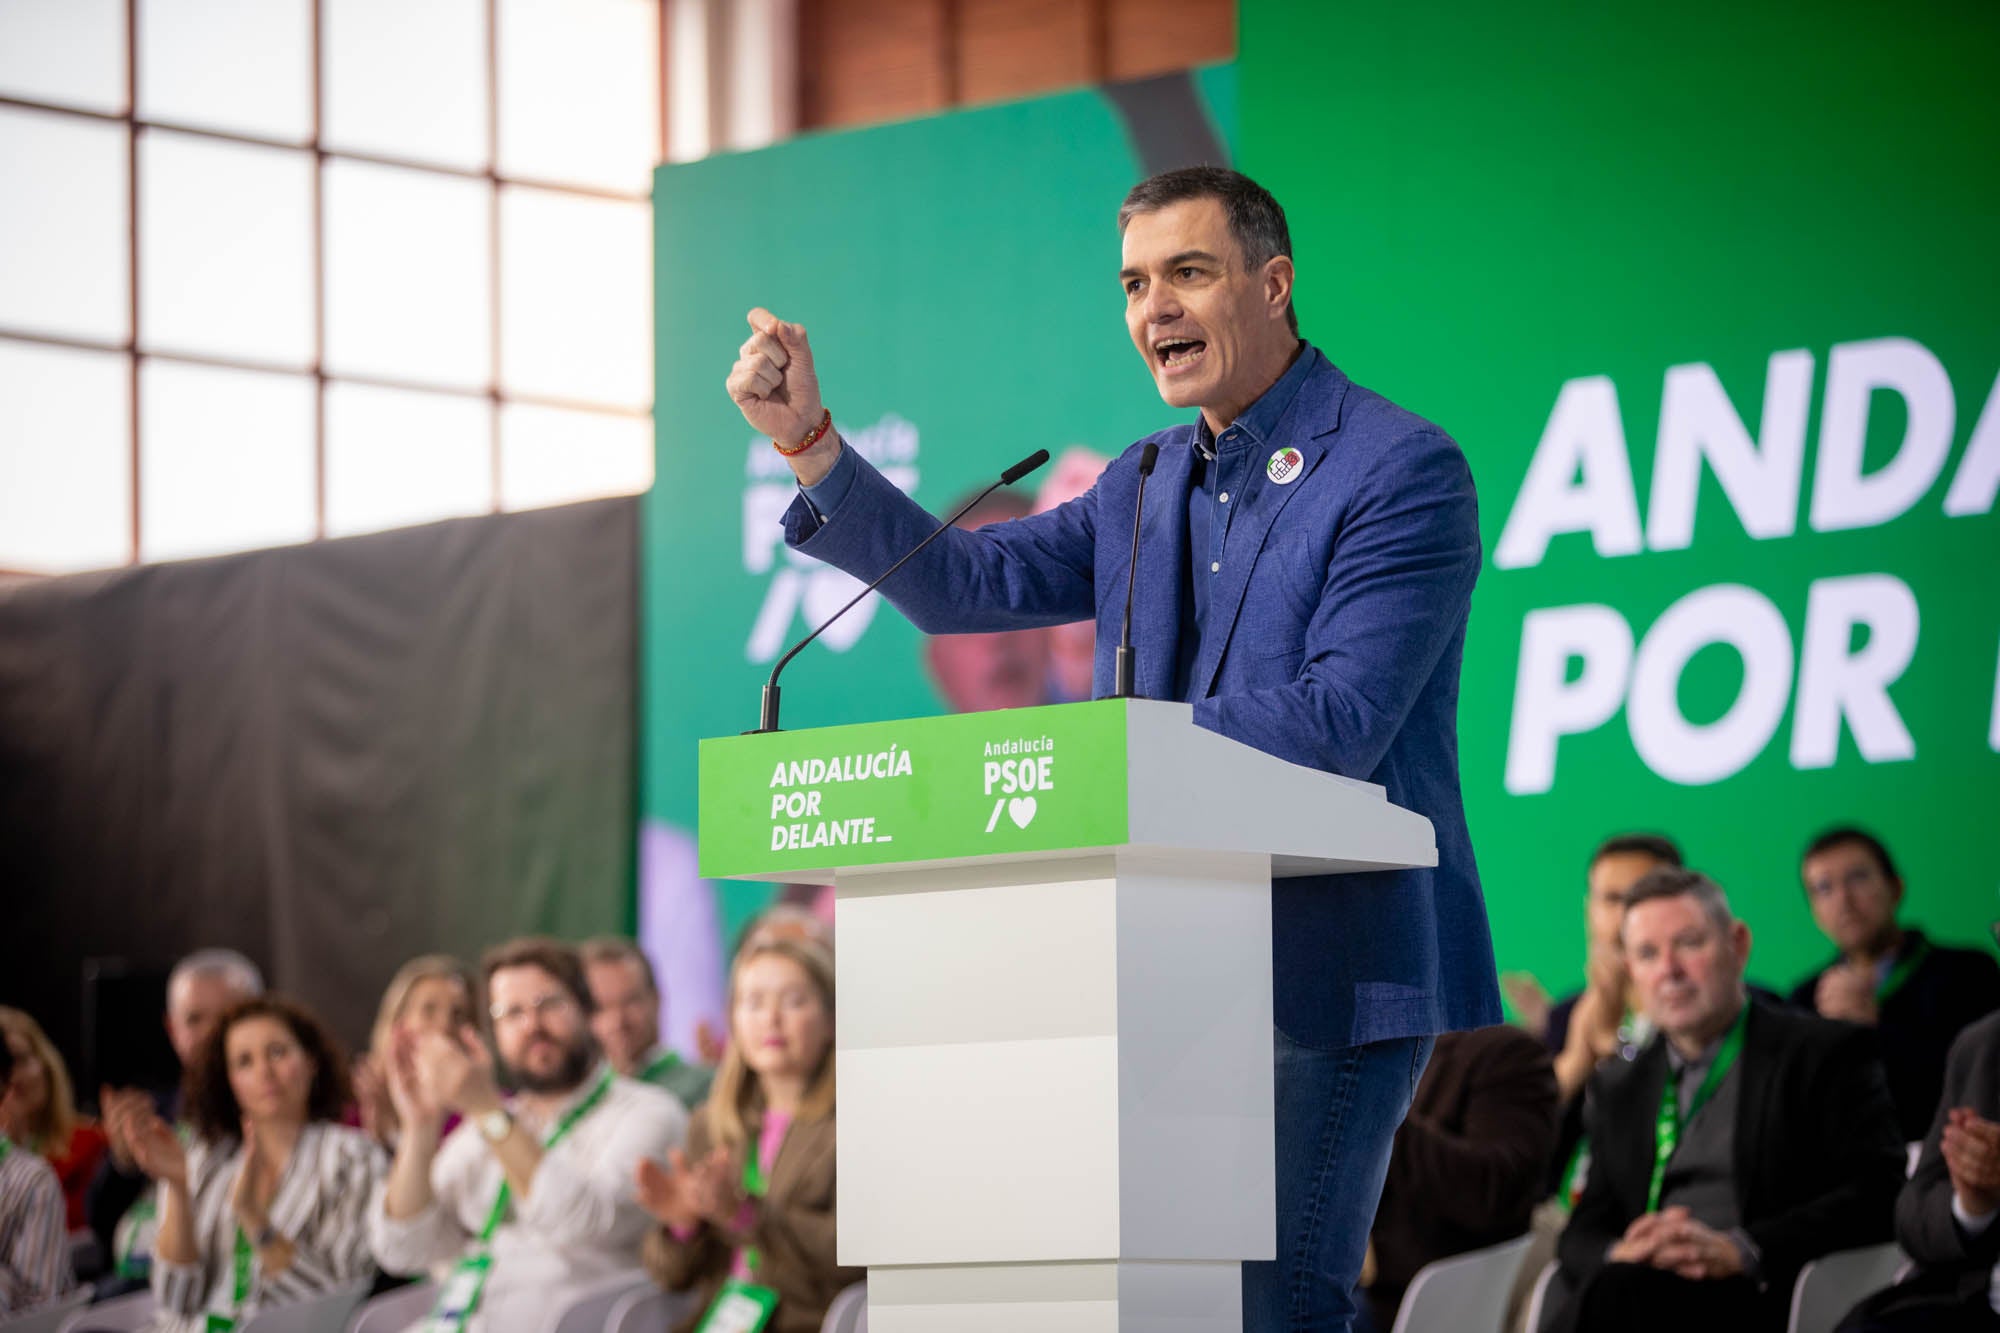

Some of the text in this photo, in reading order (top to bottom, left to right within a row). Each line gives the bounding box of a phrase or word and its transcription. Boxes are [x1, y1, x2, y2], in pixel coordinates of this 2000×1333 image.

[1503, 572, 1920, 797] POR
[769, 743, 913, 789] ANDALUCÍA
[983, 735, 1054, 757] Andalucía
[983, 756, 1054, 796] PSOE
[770, 790, 822, 820] POR
